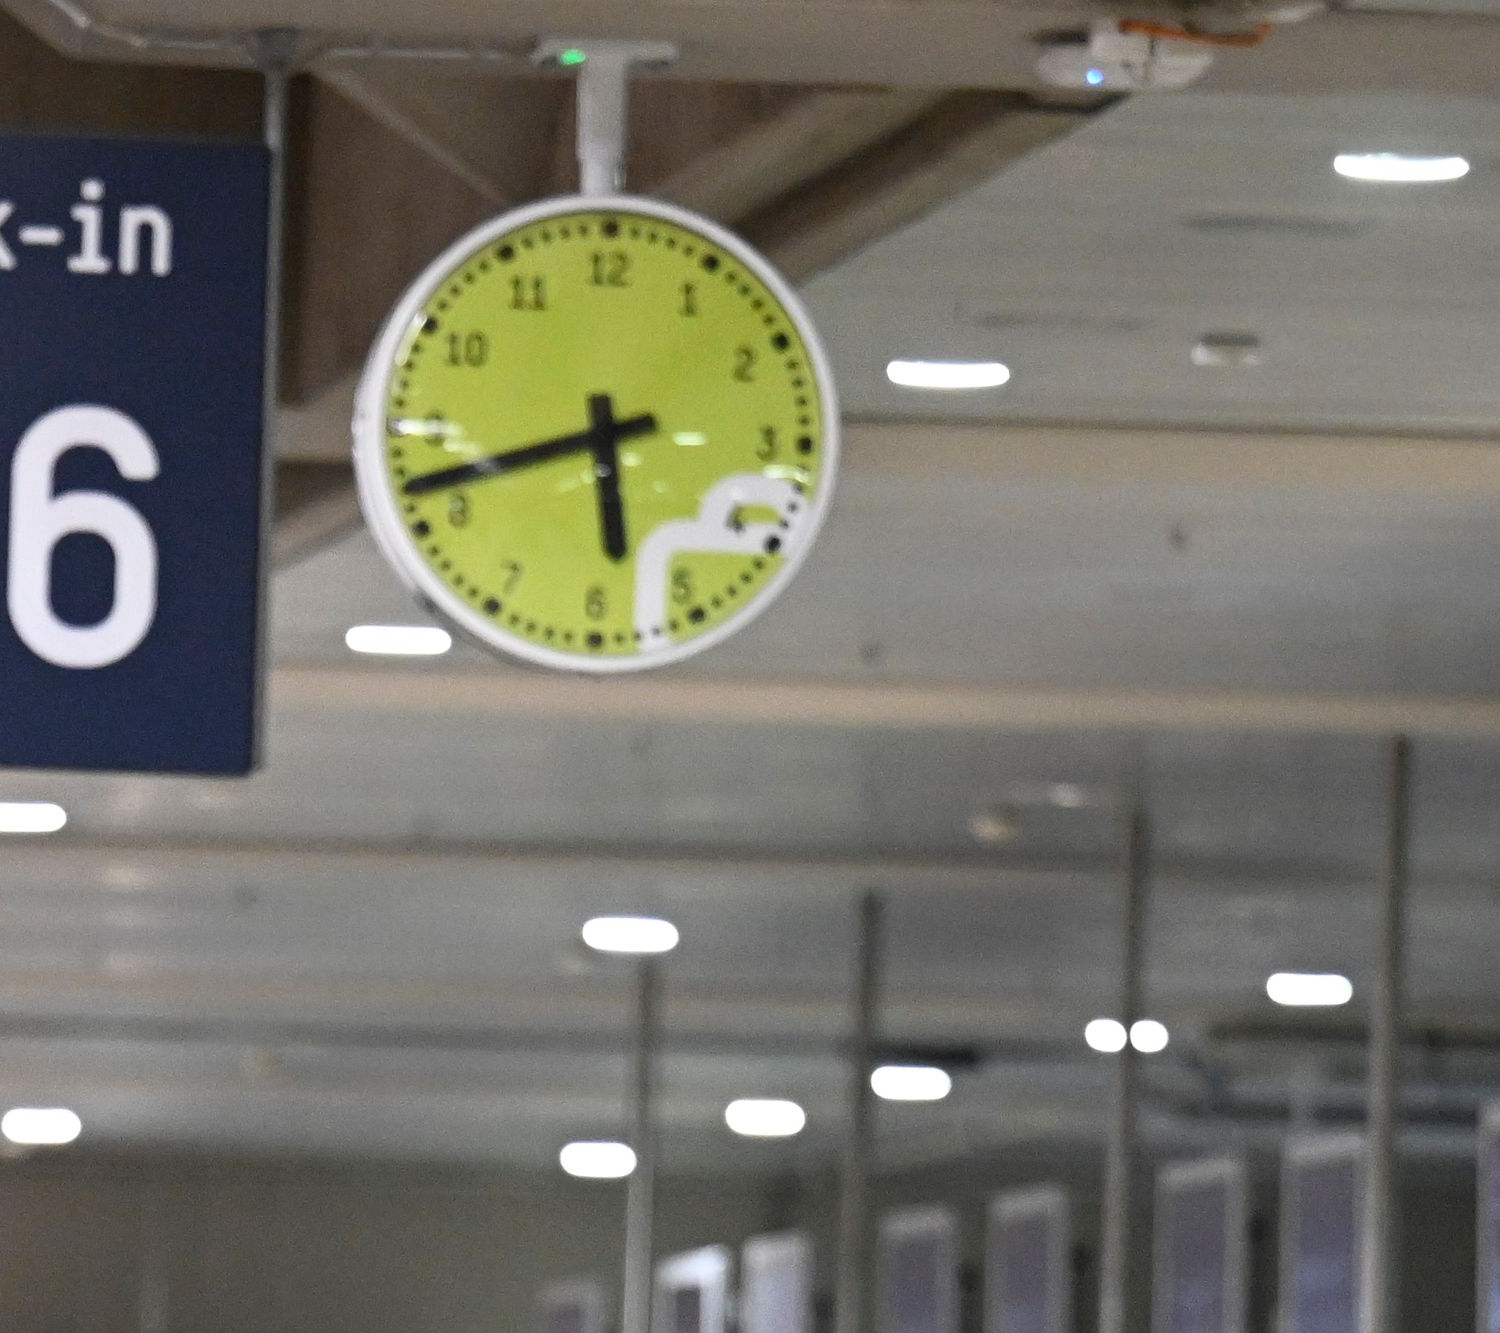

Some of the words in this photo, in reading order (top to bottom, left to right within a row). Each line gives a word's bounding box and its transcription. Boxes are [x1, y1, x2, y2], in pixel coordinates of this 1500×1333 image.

[588, 252, 632, 288] 12
[508, 276, 549, 311] 11
[679, 282, 698, 317] 1
[443, 331, 489, 367] 10
[731, 346, 756, 383] 2
[756, 425, 780, 462] 3
